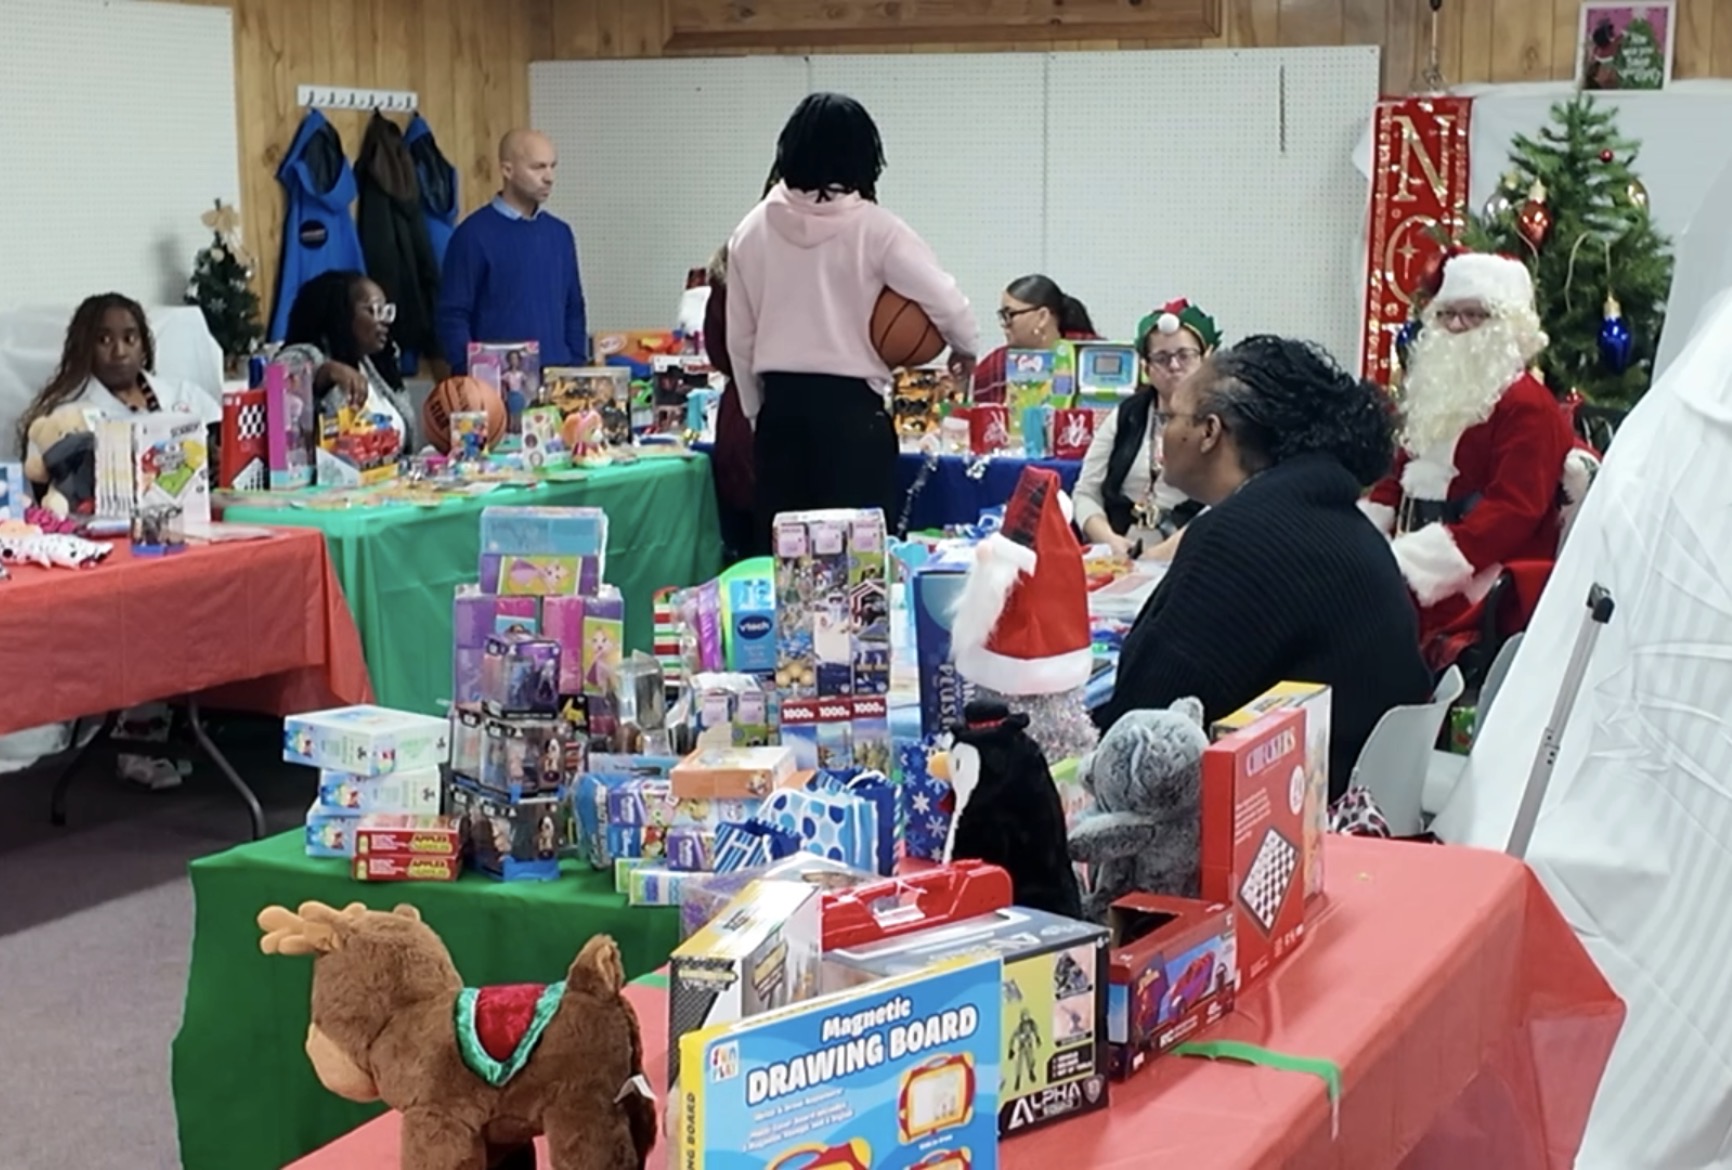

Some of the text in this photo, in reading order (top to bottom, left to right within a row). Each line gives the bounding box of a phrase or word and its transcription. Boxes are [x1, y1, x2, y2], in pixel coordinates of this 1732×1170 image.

[822, 996, 912, 1043] Magnetic
[747, 1032, 885, 1105] DRAWING
[888, 1005, 978, 1060] BOARD
[686, 1092, 696, 1145] BOARD
[1008, 1081, 1081, 1130] ALPHA
